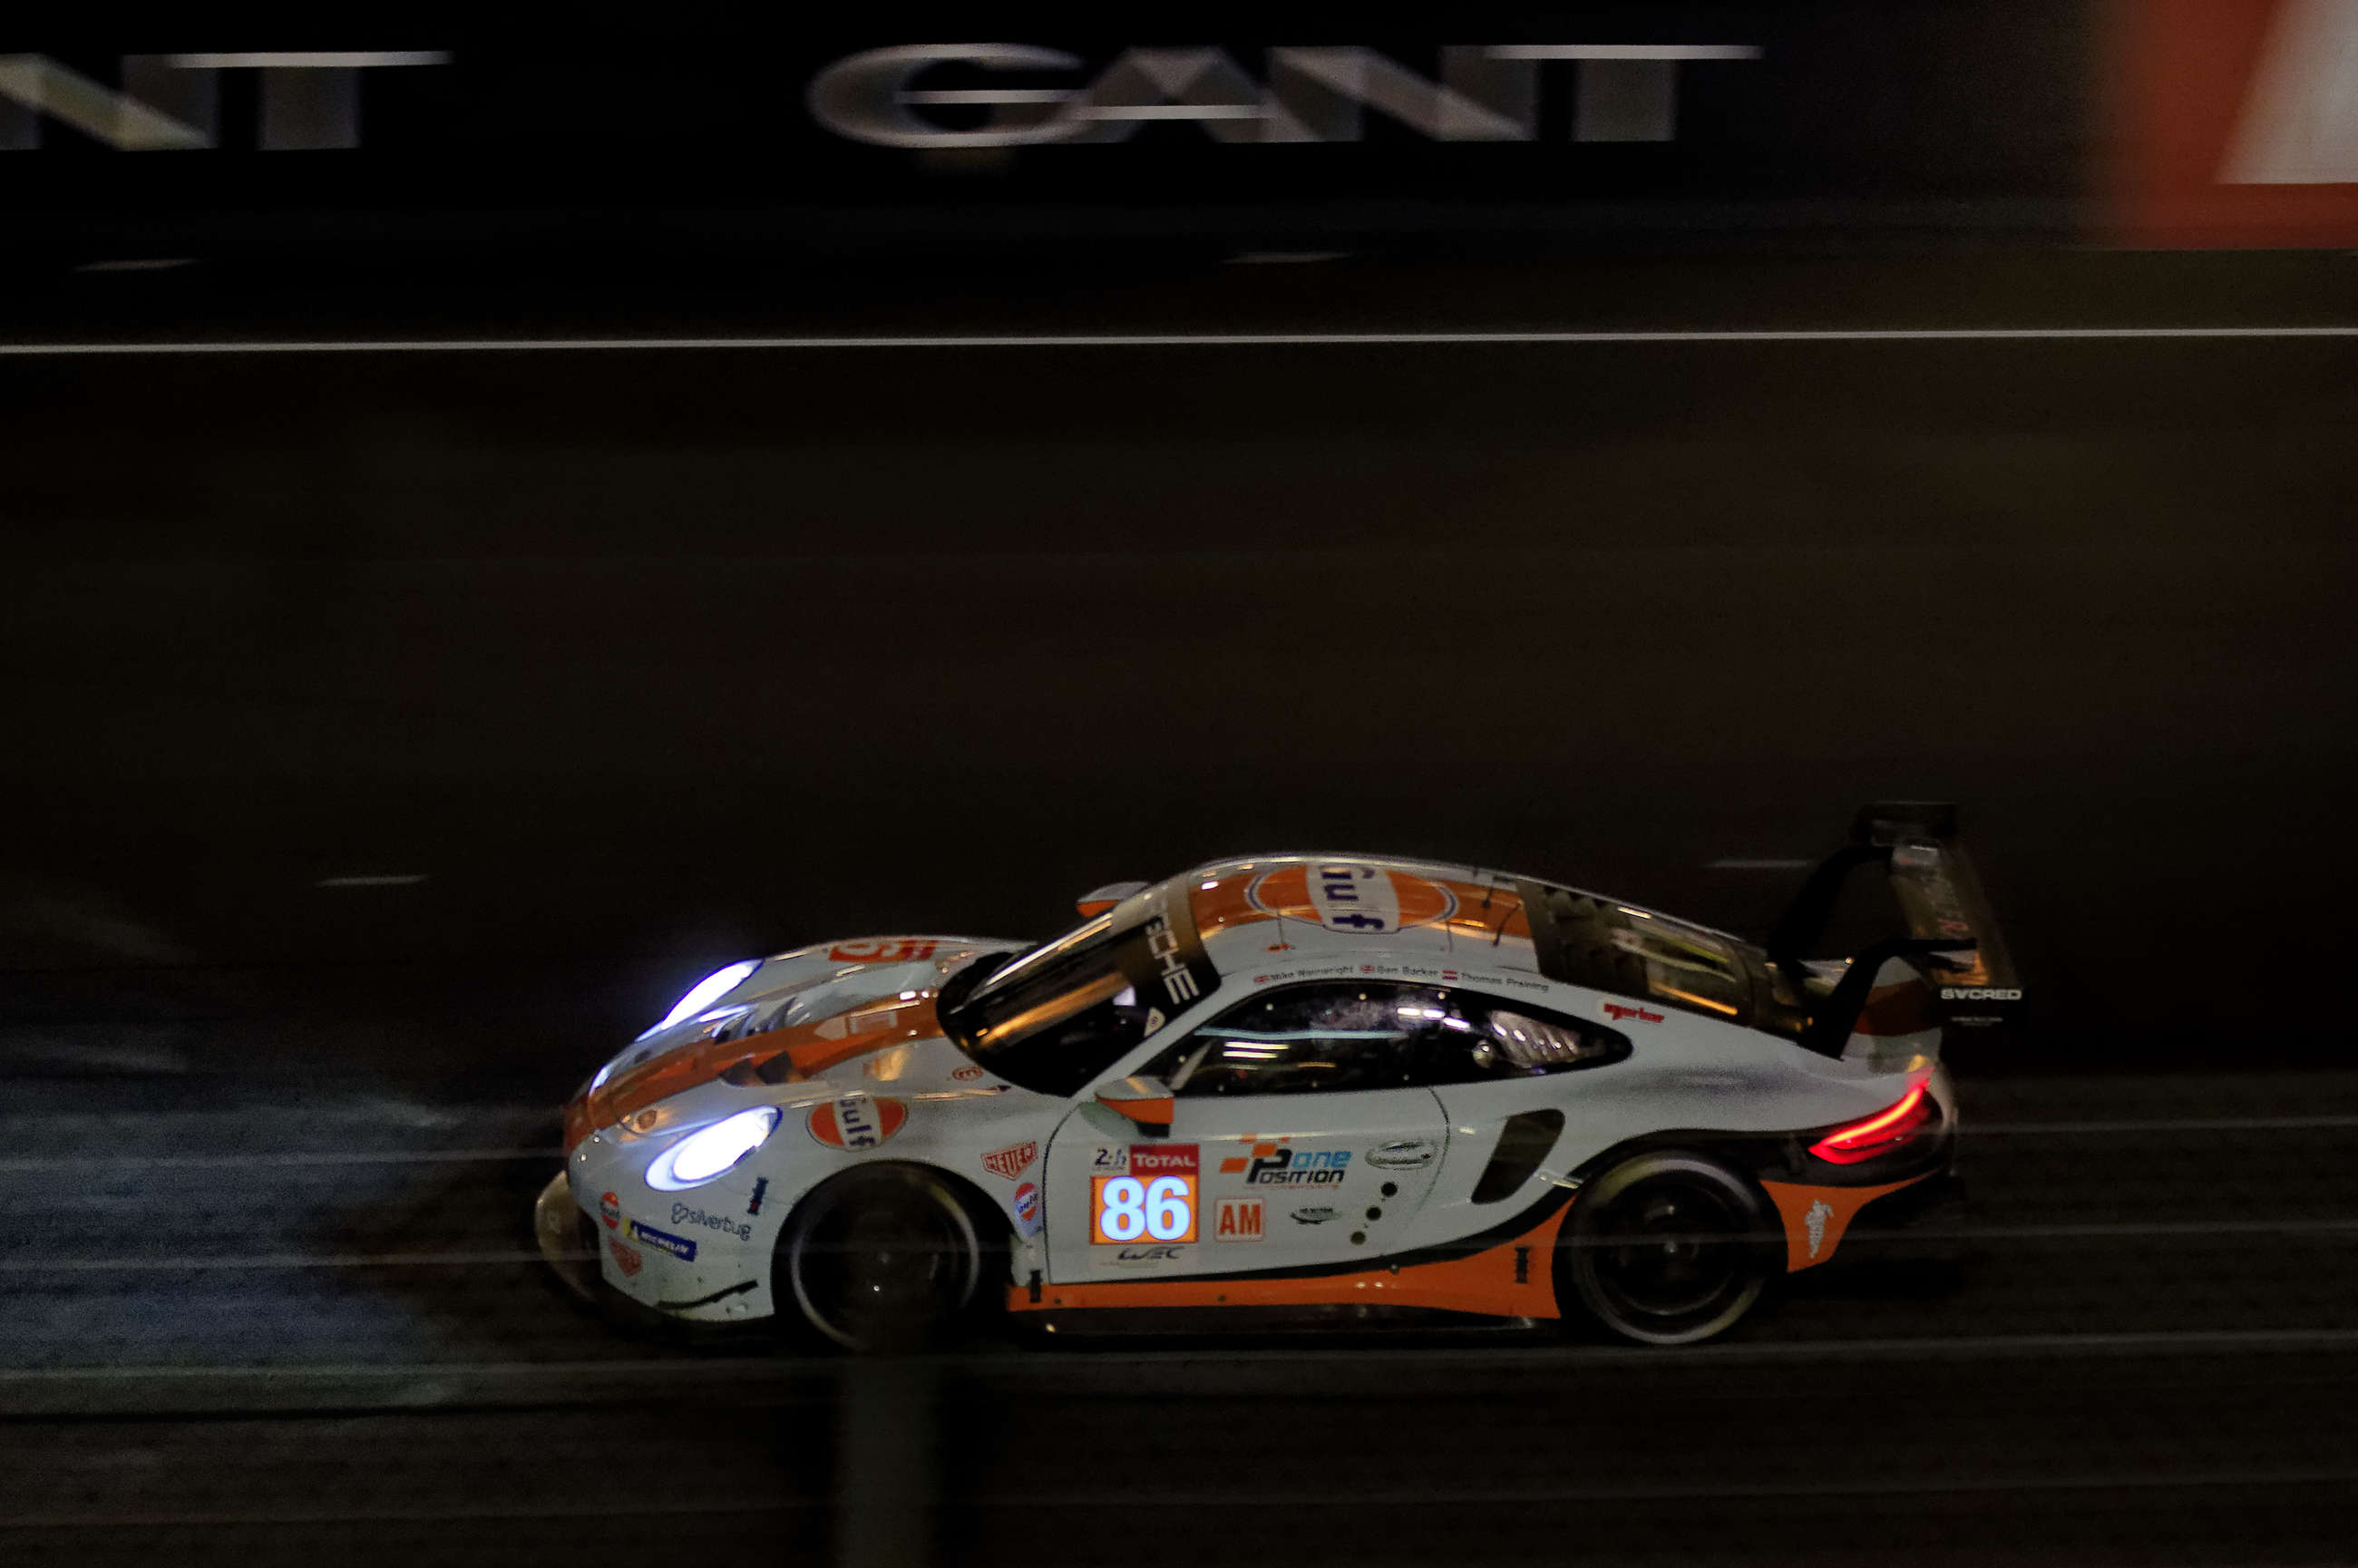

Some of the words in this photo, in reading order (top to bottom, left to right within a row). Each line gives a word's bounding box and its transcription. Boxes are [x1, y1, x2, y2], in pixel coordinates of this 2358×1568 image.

[805, 42, 1763, 148] GANT
[1133, 1153, 1196, 1168] TOTAL
[1100, 1174, 1191, 1241] 86
[1219, 1203, 1262, 1235] AM
